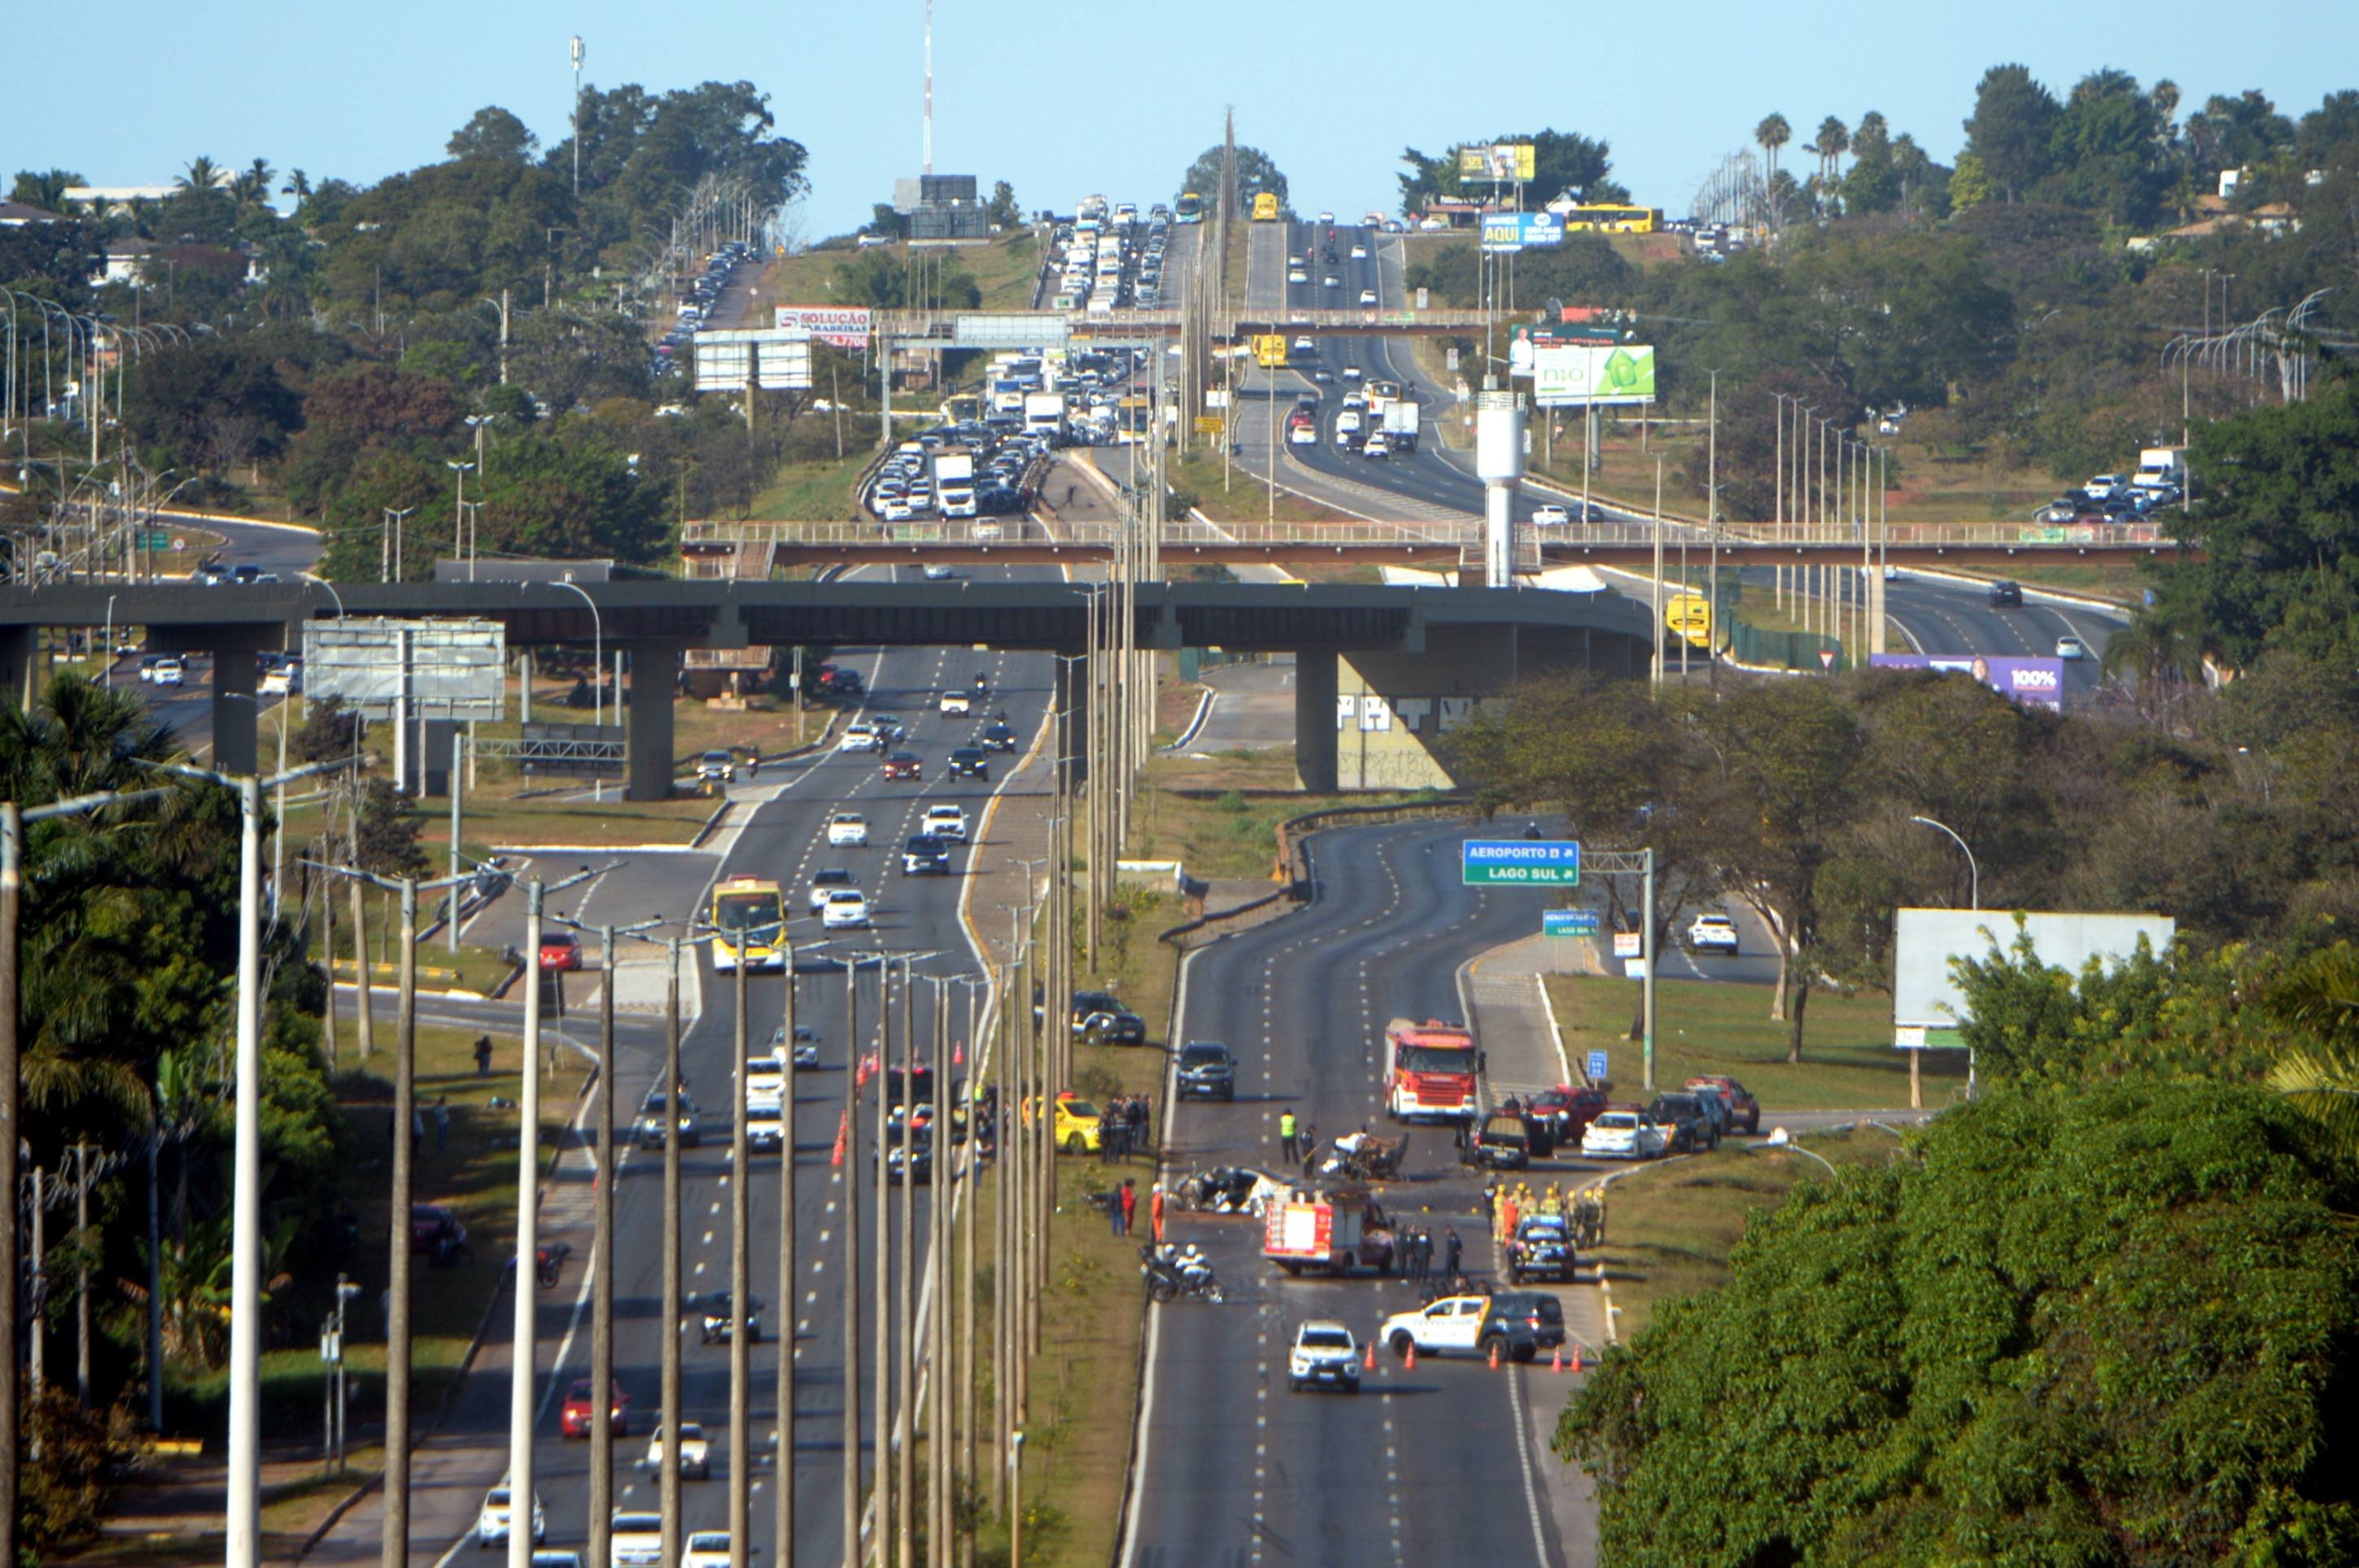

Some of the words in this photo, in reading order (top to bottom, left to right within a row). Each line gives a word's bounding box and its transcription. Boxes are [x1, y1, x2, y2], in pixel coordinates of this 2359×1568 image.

[1483, 226, 1519, 242] AQUI
[800, 312, 867, 325] SOLUÇÃO
[2012, 670, 2057, 686] 100%
[1470, 847, 1547, 858] AEROPORTO
[1489, 867, 1527, 879] LAGO
[1531, 868, 1559, 880] SUL
